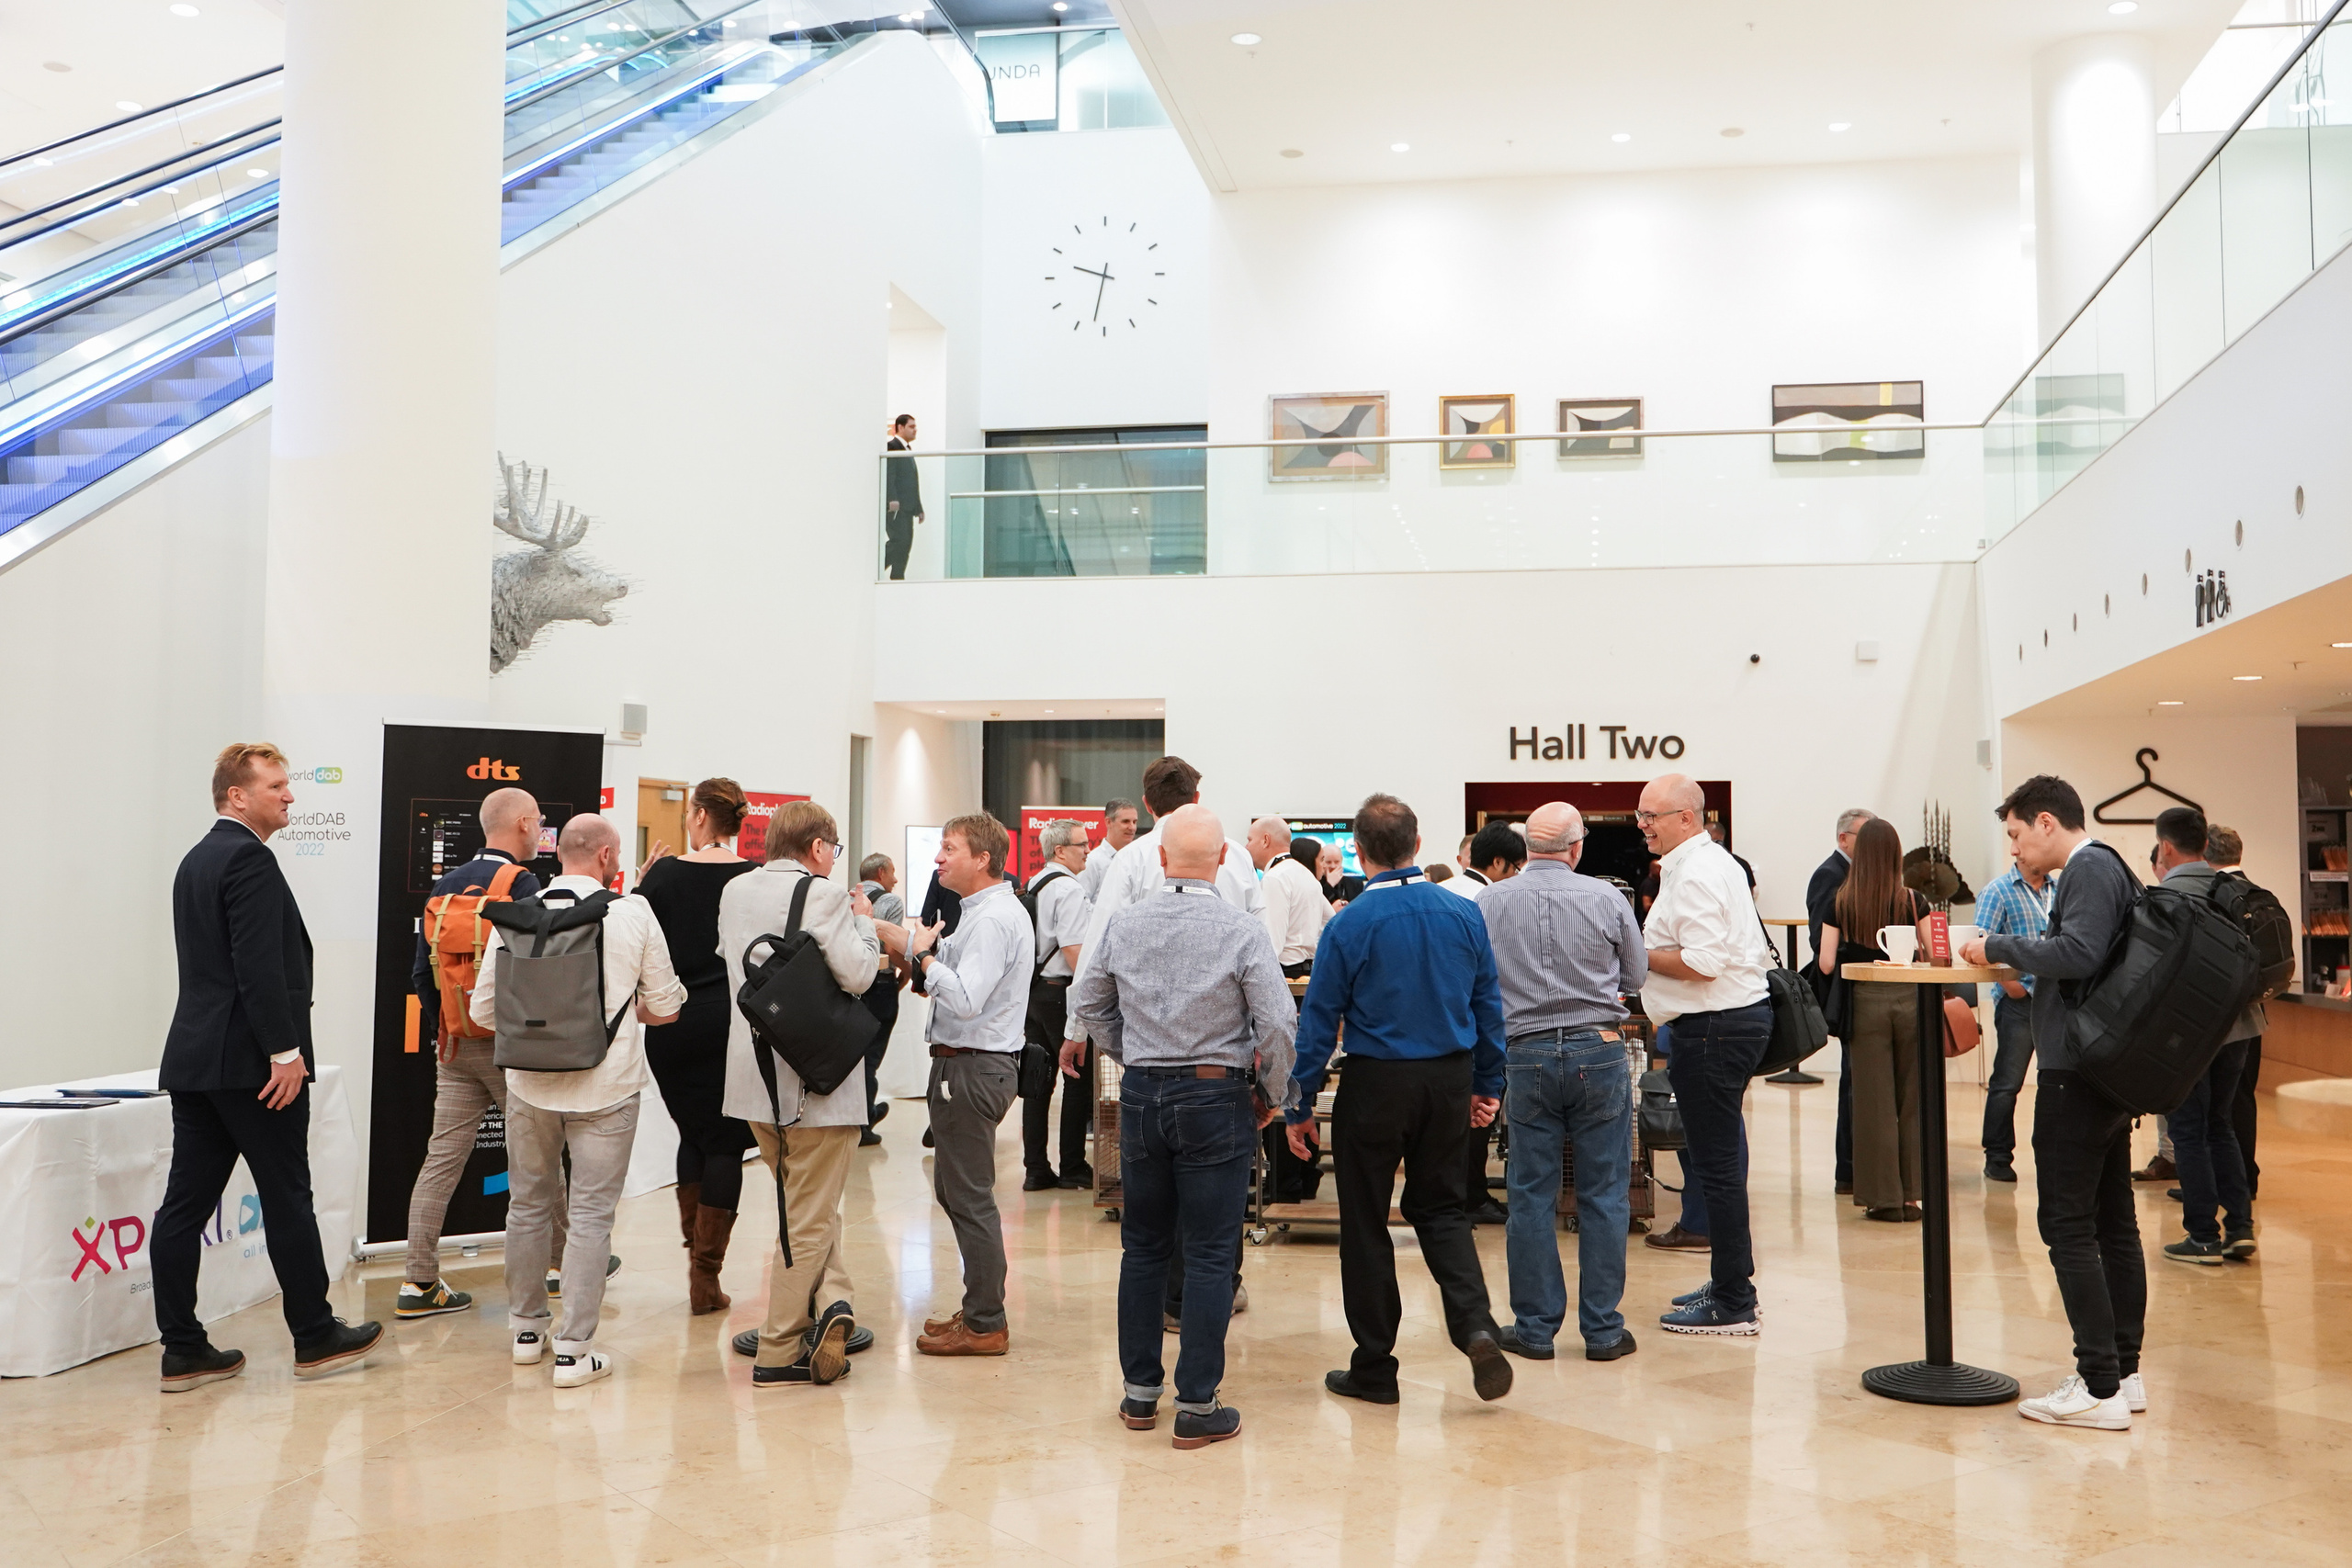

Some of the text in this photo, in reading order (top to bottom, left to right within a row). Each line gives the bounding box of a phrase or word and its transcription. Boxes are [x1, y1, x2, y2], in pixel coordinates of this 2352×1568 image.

[1510, 723, 1685, 761] Hall Two
[466, 756, 521, 782] dts
[747, 802, 778, 818] Radiopl
[277, 828, 352, 840] Automotive
[295, 842, 325, 856] 2022
[243, 1243, 256, 1258] all
